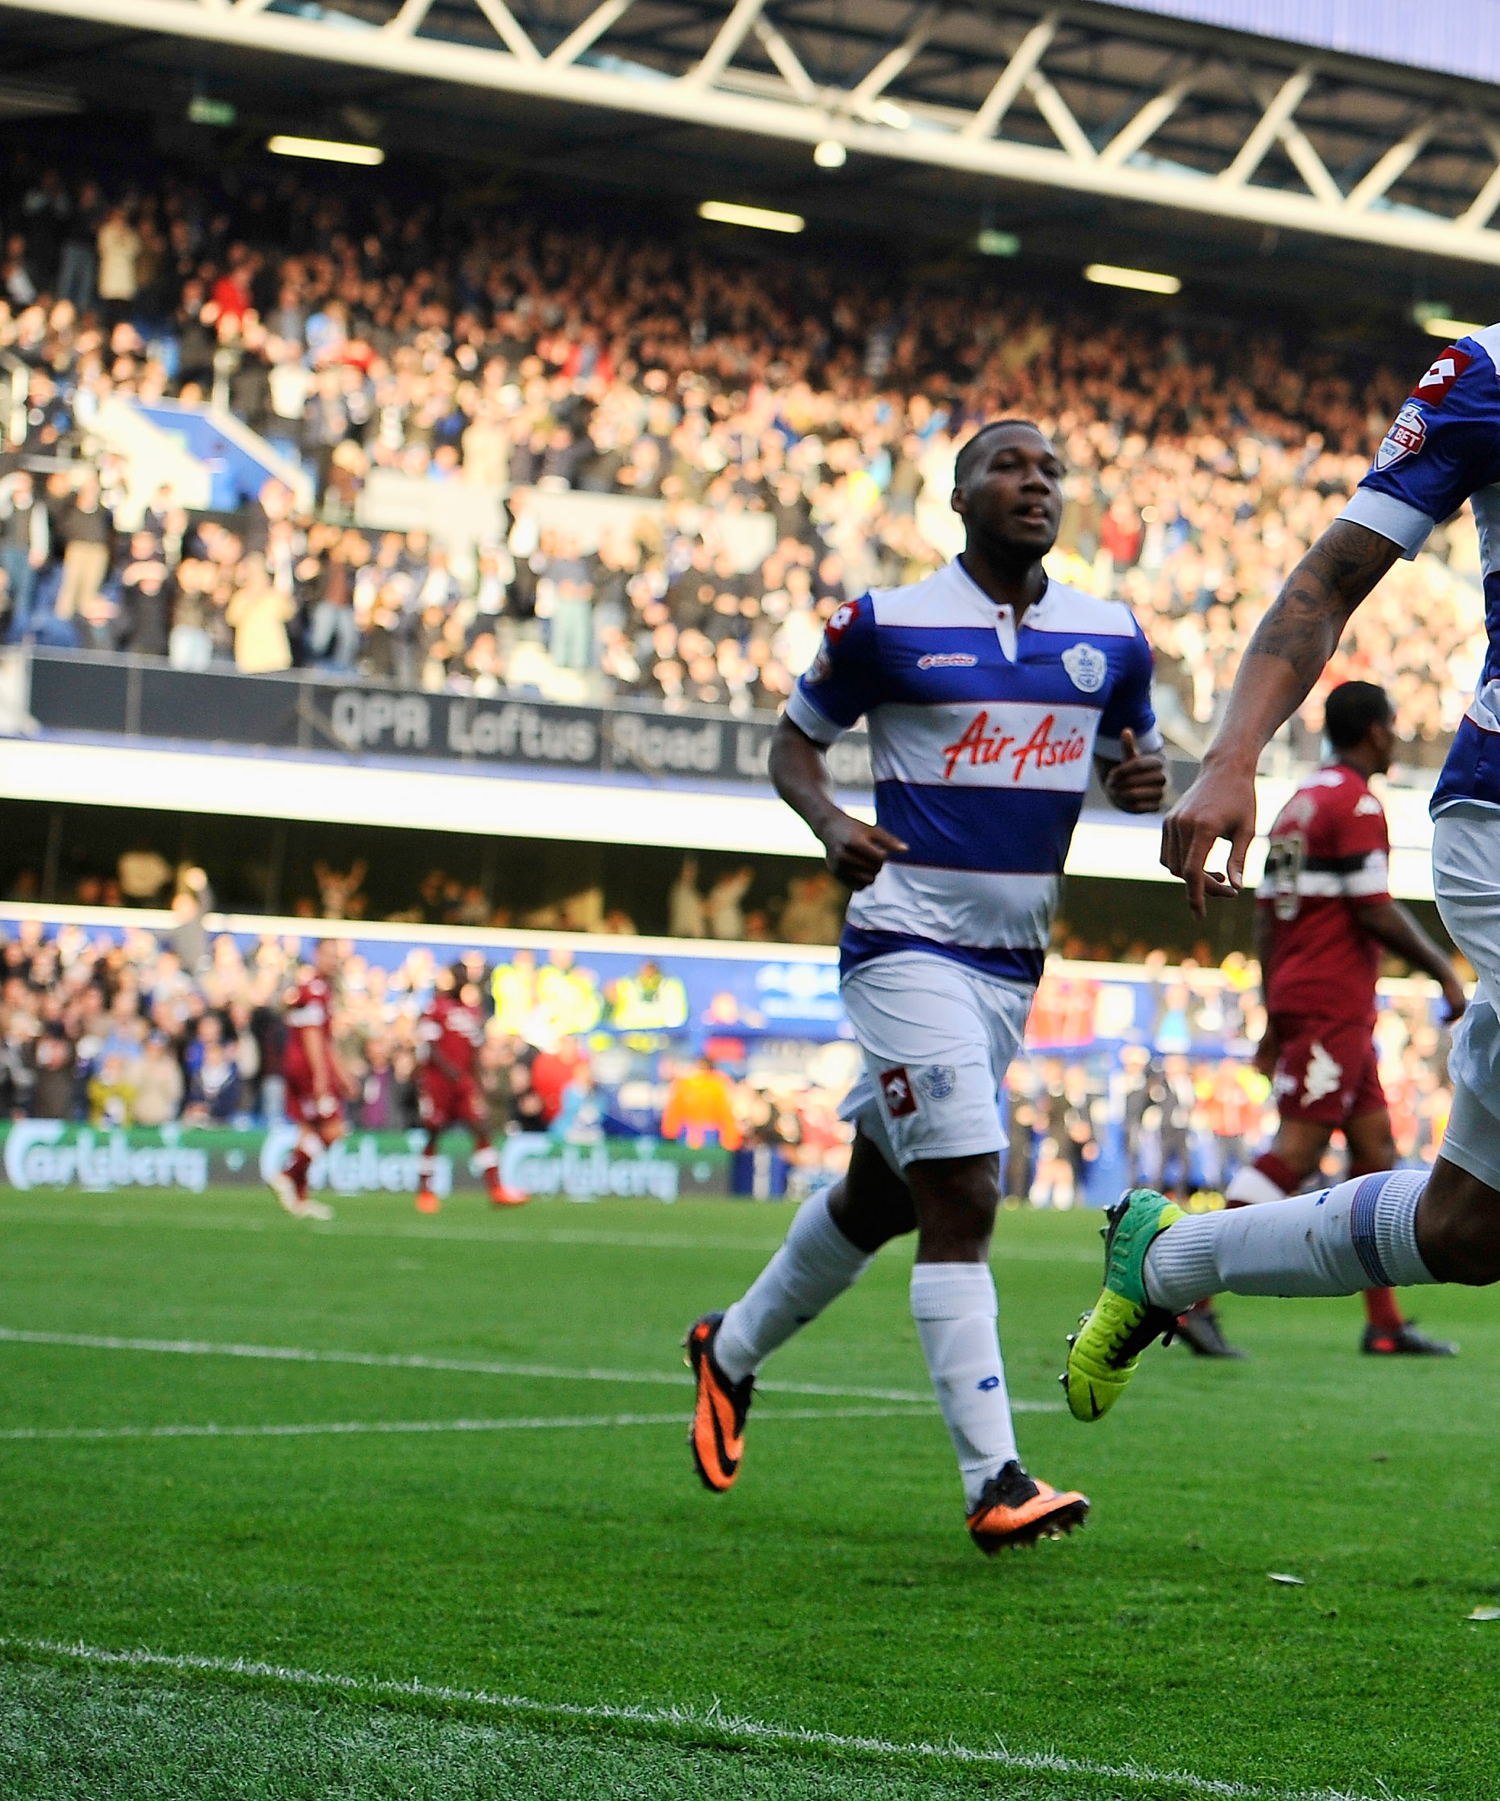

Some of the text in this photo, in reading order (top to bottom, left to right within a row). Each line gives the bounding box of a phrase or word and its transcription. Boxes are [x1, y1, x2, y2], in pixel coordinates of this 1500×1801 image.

[1394, 427, 1421, 448] BET
[332, 690, 430, 748] QPR
[448, 701, 596, 761] Loftus
[612, 713, 721, 771] Road
[943, 711, 1085, 782] Air Asia
[5, 1117, 208, 1193] Carlsberg
